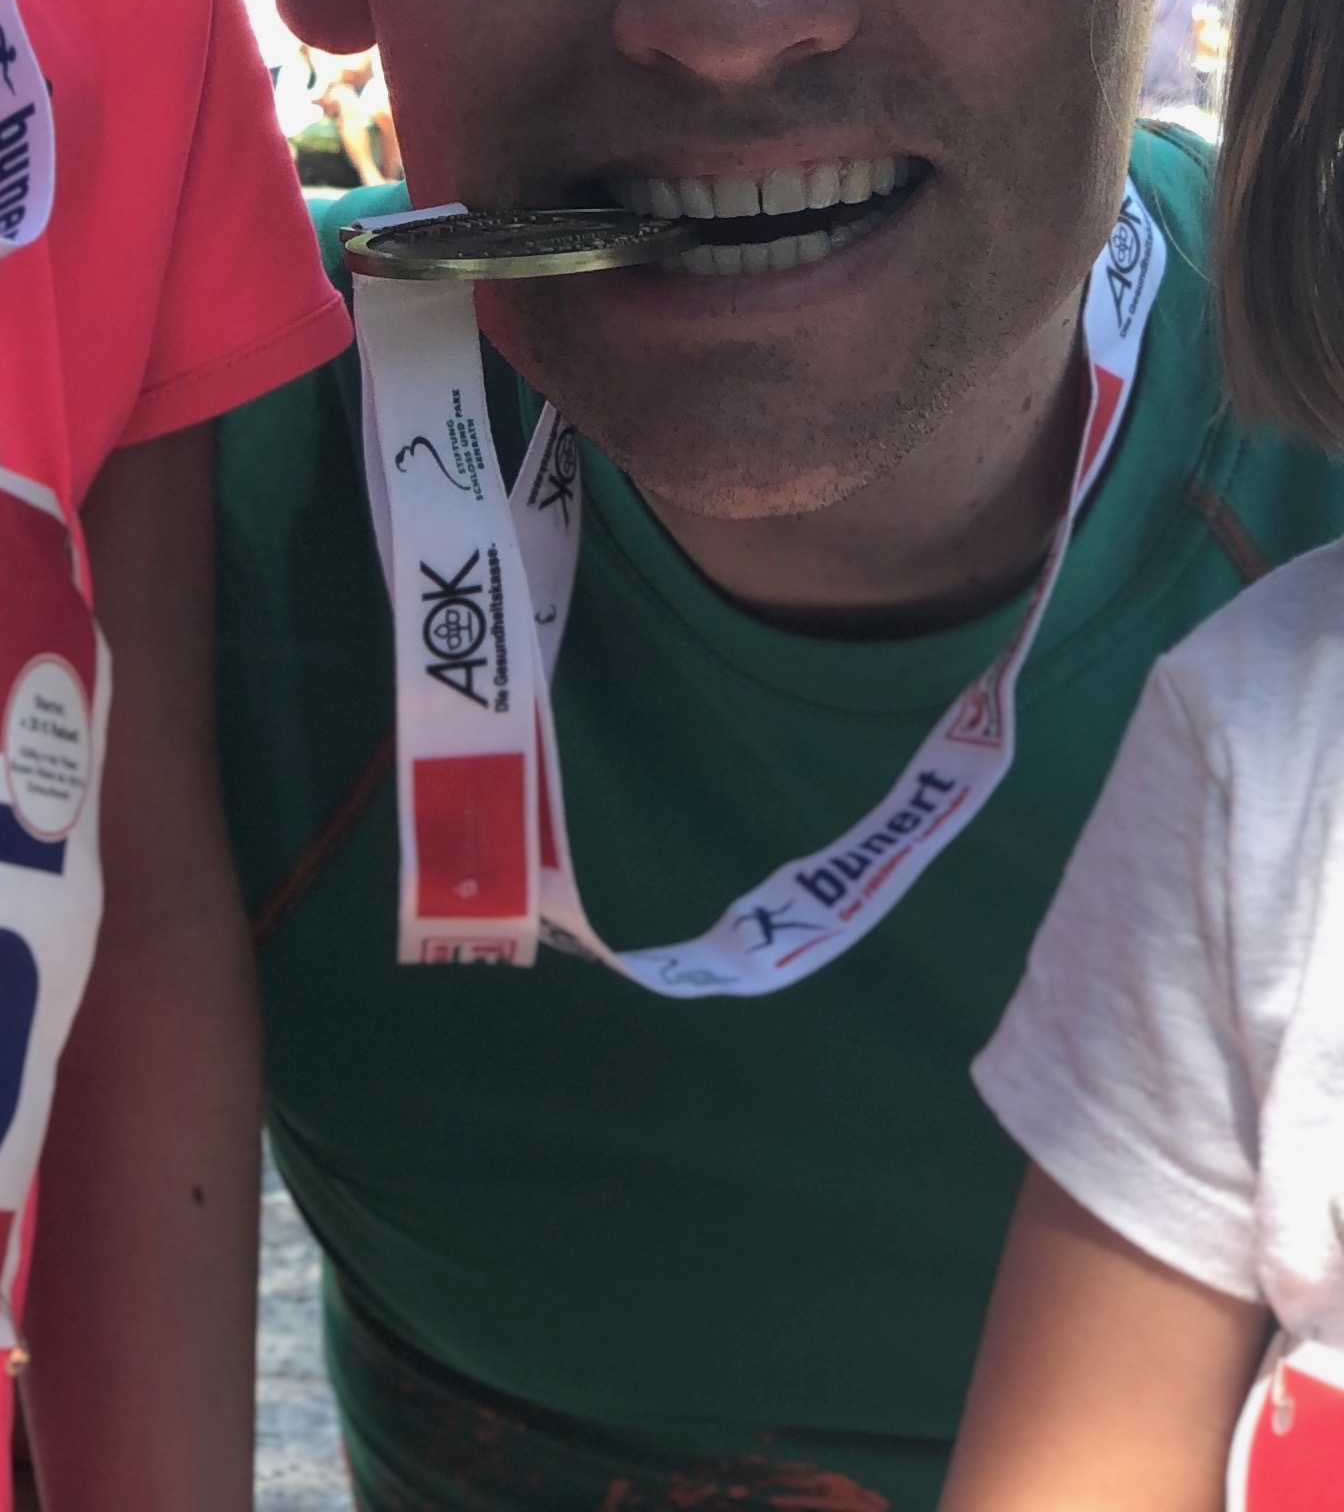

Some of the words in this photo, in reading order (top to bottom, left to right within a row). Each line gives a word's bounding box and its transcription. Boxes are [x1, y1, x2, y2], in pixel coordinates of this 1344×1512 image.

[452, 389, 462, 418] PARK
[446, 419, 466, 474] STIFTUNG
[457, 421, 470, 447] UND
[467, 418, 484, 469] BENRATH
[463, 449, 484, 501] SCHLOSS
[538, 426, 576, 528] OK
[419, 548, 489, 709] AOK
[494, 690, 509, 713] Die
[792, 769, 956, 909] bunert
